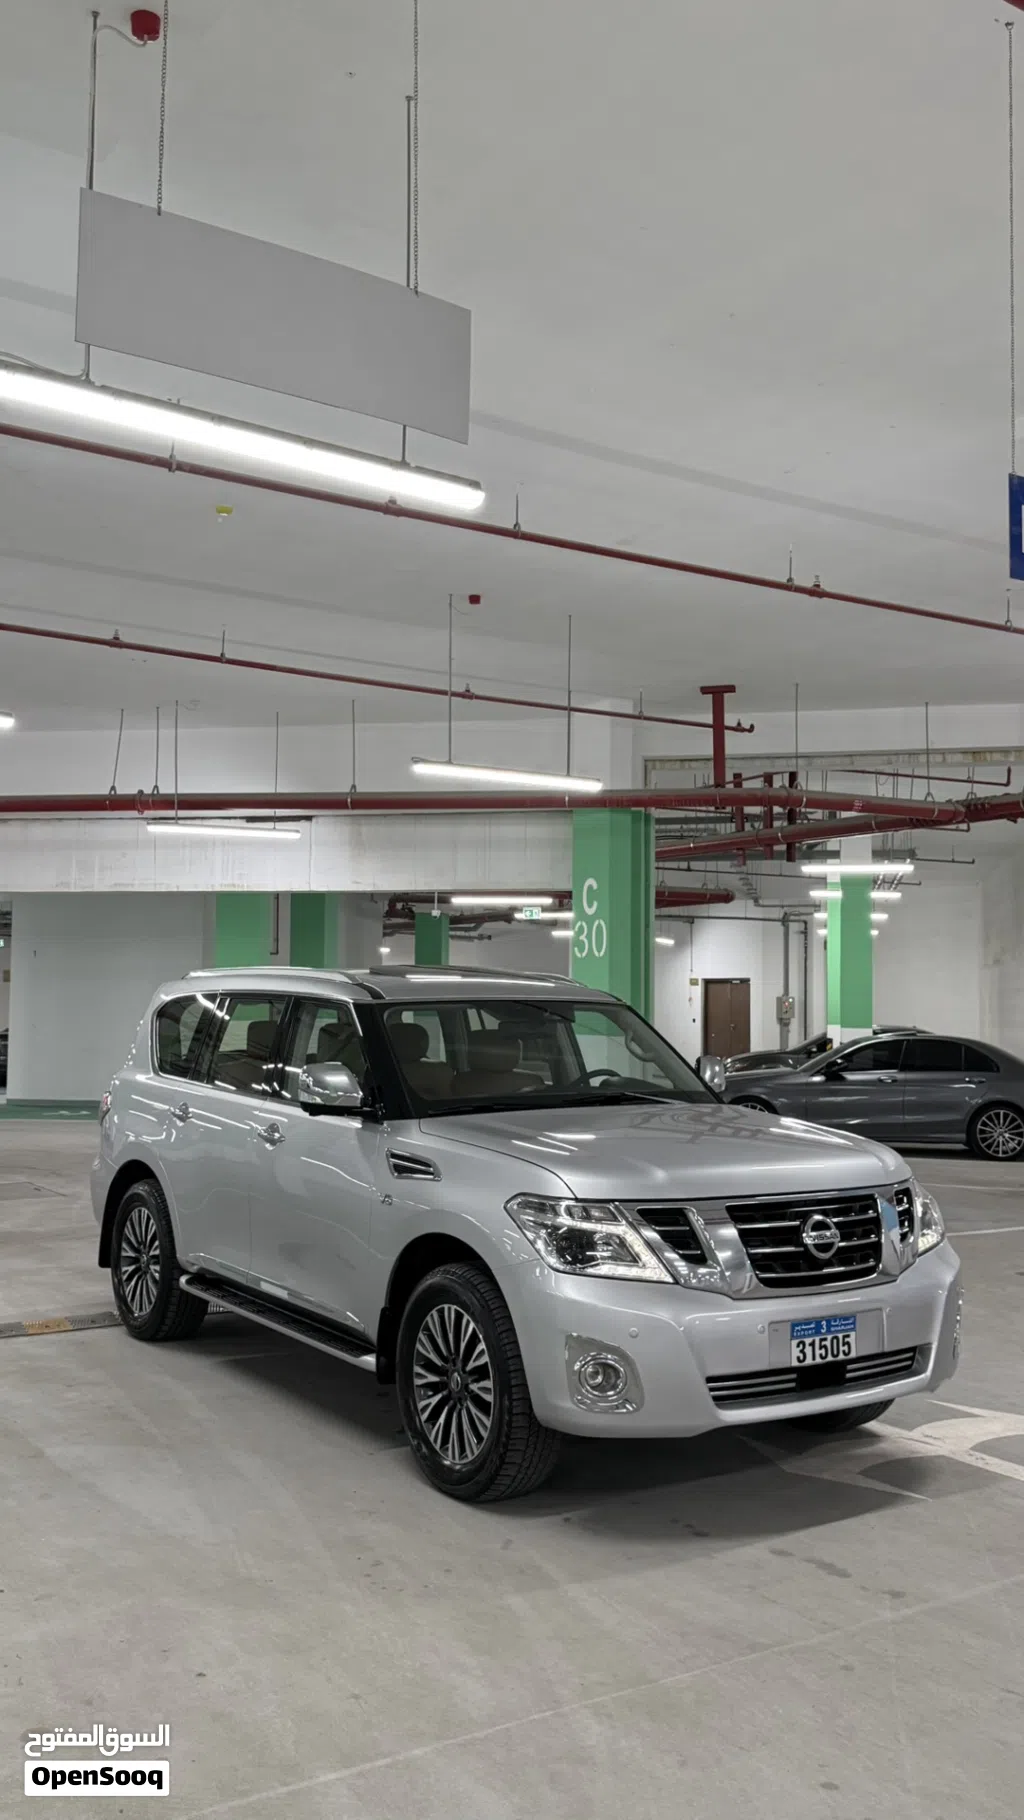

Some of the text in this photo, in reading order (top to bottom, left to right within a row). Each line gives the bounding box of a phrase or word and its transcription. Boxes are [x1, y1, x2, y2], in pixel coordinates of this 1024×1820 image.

[582, 877, 598, 916] C
[574, 919, 607, 957] 30
[793, 1329, 816, 1337] EXPORT
[820, 1320, 827, 1333] 3
[796, 1333, 852, 1364] 31505
